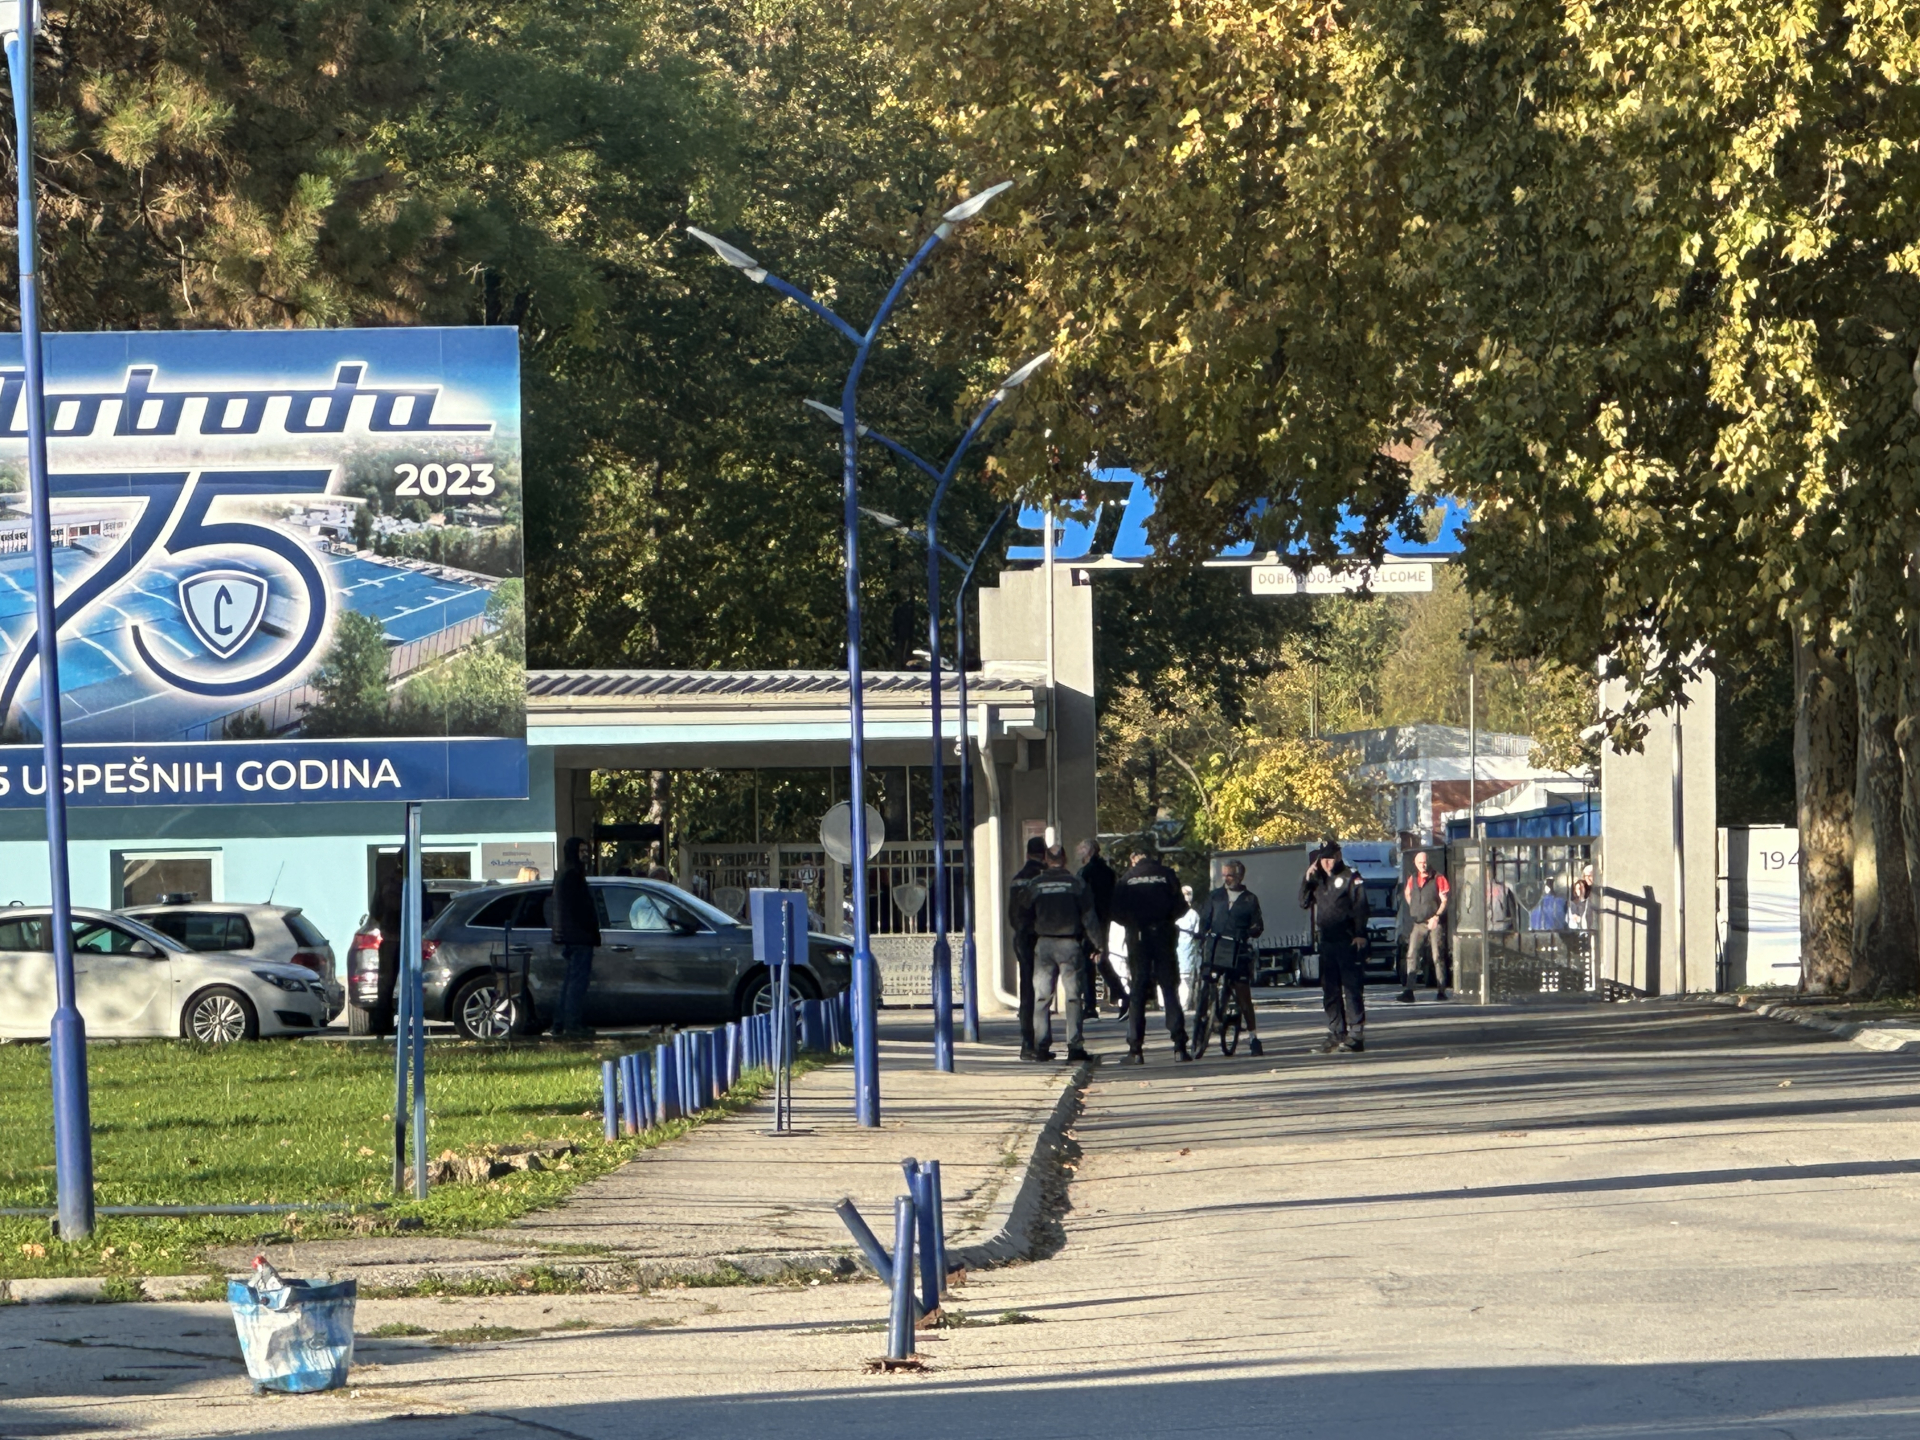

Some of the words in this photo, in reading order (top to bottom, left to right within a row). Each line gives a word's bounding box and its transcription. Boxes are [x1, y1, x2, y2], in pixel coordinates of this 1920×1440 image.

[394, 463, 496, 496] 2023
[1363, 571, 1427, 583] ELCOME
[0, 469, 333, 728] 75
[22, 756, 223, 796] USPEŠNIH
[236, 758, 402, 792] GODINA
